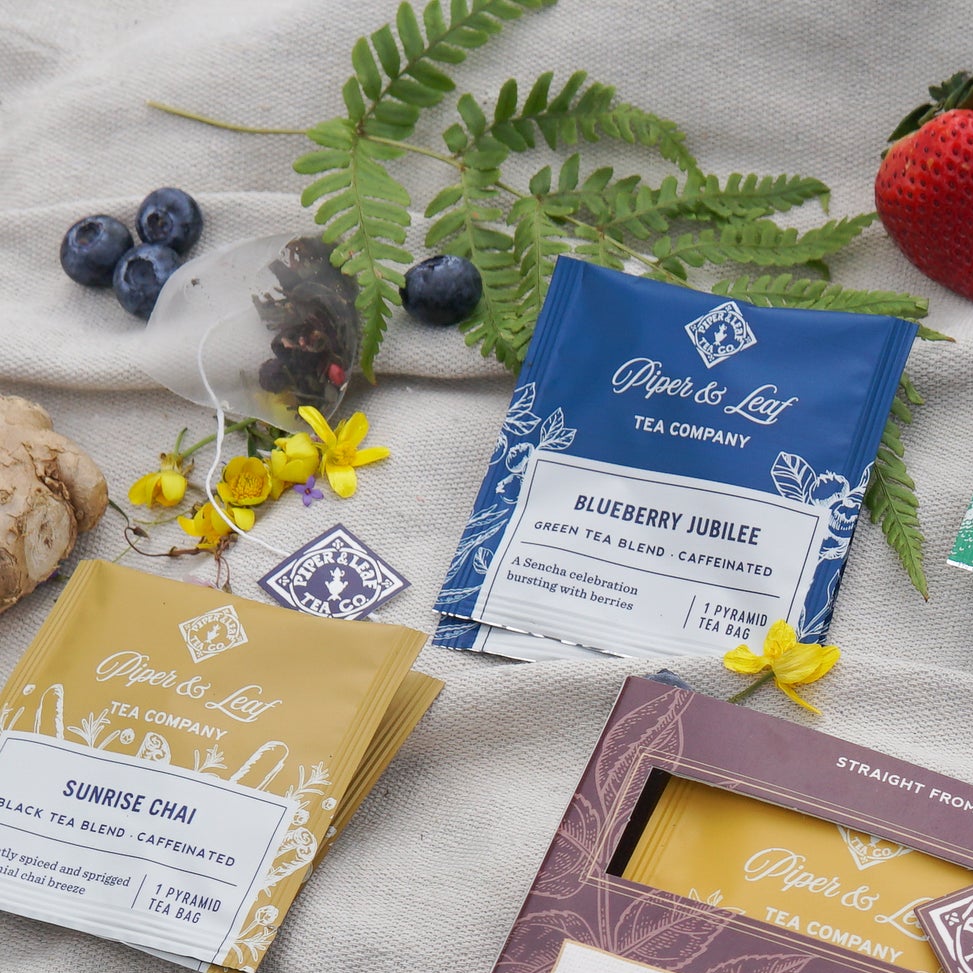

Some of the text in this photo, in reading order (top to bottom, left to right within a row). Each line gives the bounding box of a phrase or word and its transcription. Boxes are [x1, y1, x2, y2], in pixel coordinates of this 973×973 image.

[611, 357, 799, 425] Piper & Leaf
[634, 415, 751, 449] TEA COMPANY
[573, 494, 762, 546] BLUEBERRY JUBILEE
[534, 521, 773, 577] GREEN TEA BLEND CAFFEINATED
[506, 569, 634, 611] bursting with berries
[511, 556, 638, 596] A Sencha celebration
[698, 616, 751, 640] TEA BAG
[704, 602, 768, 627] 1 PYRAMID
[95, 649, 283, 724] Piper & Leaf
[110, 700, 228, 741] TEA COMPANY
[836, 756, 926, 794] STRAIGHT
[62, 779, 197, 825] SUNRISE CHAI
[50, 811, 75, 828] TEA
[80, 820, 126, 838] BLEND
[137, 832, 235, 867] CAFFEINATED
[742, 847, 880, 911] Piper &
